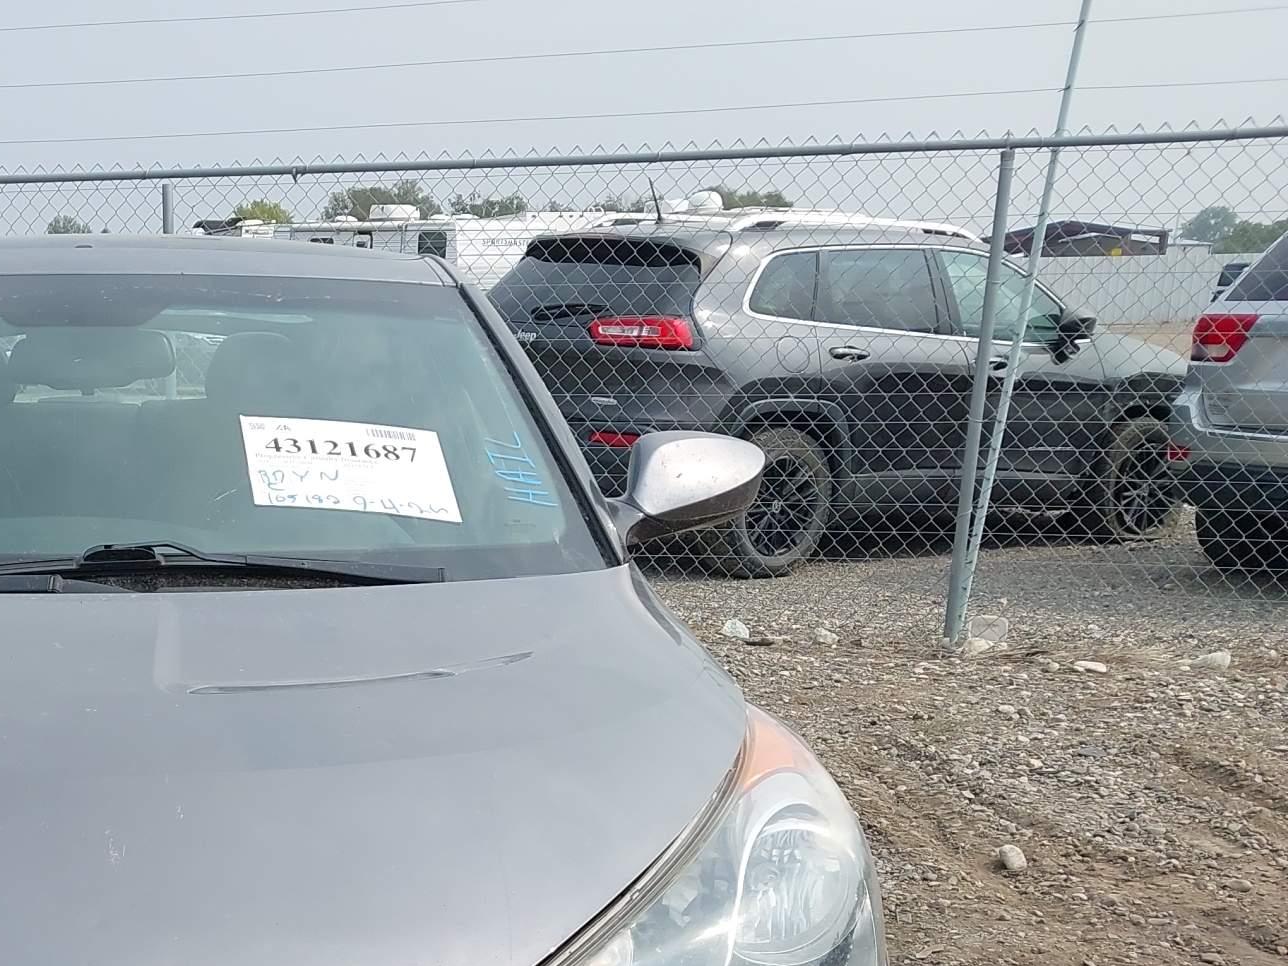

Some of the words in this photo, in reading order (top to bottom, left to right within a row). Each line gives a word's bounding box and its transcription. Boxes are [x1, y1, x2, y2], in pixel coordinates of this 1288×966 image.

[514, 328, 537, 343] Jeep
[265, 437, 417, 463] 43121687
[484, 432, 558, 507] HAIL
